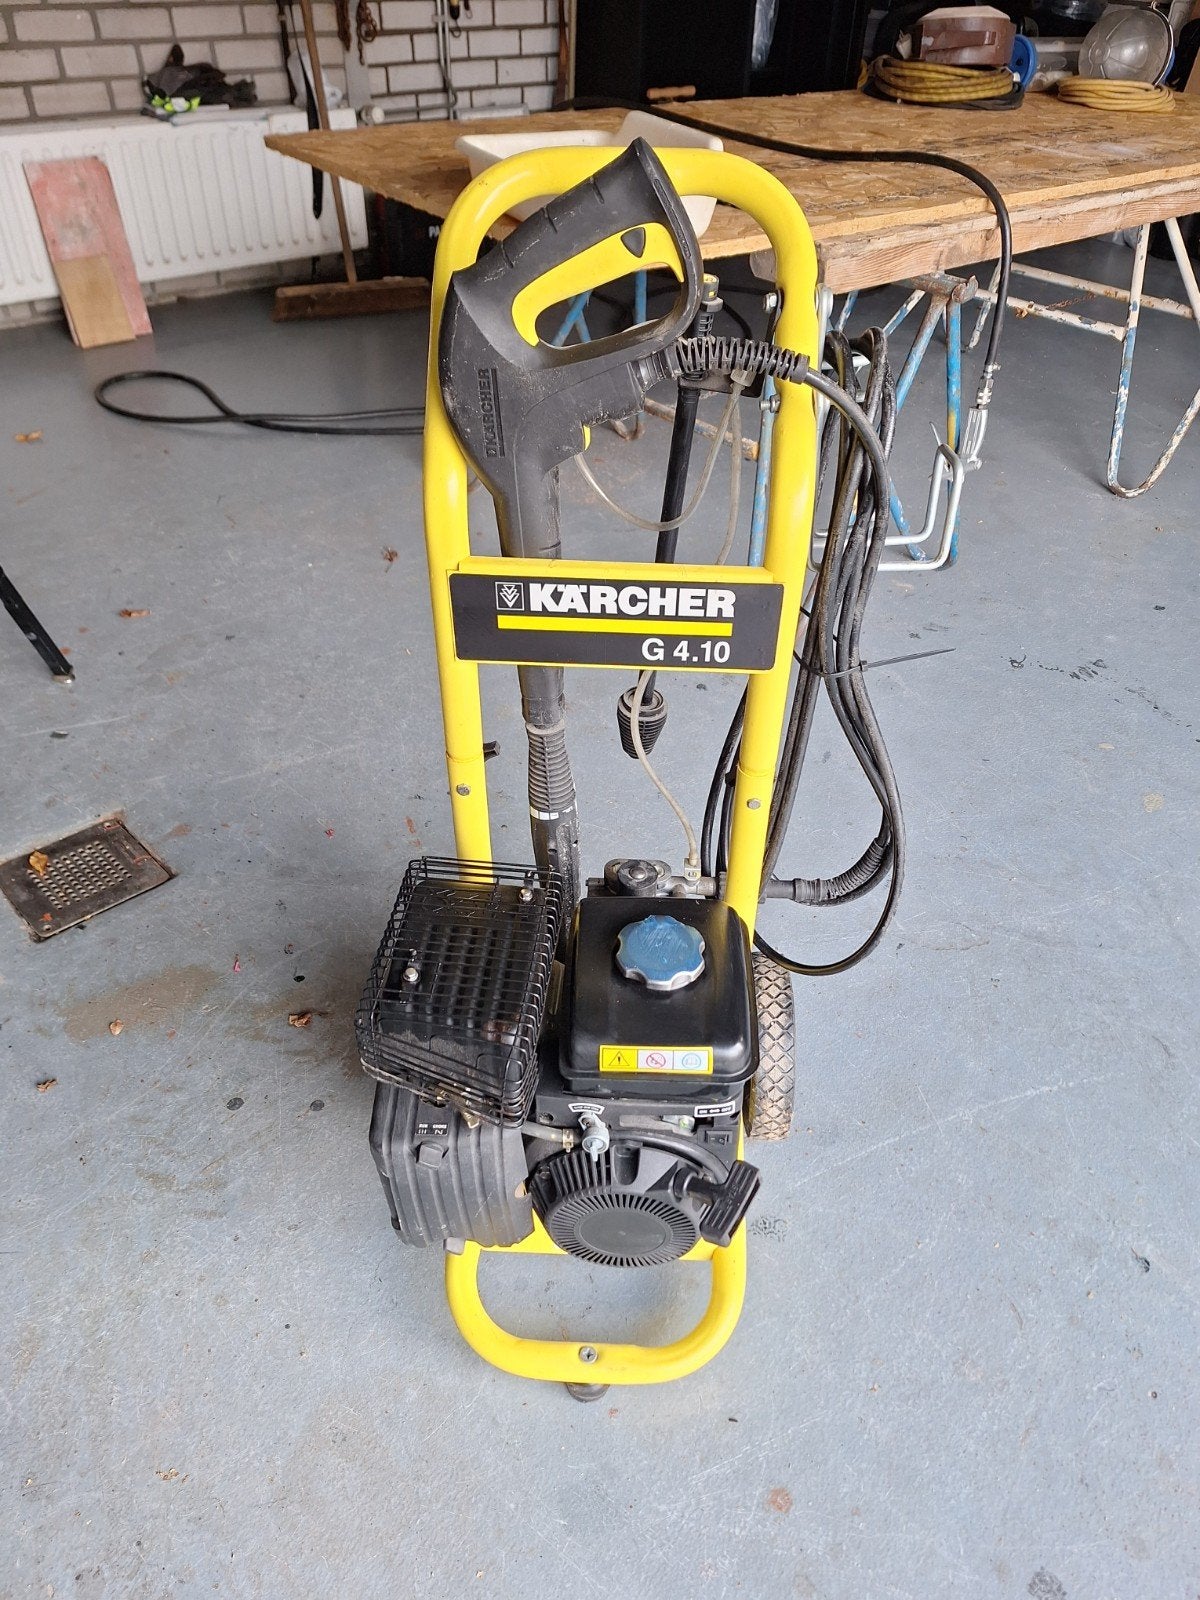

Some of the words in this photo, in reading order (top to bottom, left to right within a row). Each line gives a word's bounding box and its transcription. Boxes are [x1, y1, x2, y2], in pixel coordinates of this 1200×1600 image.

[529, 583, 736, 618] KÄRCHER
[641, 638, 665, 660] G
[672, 641, 731, 663] 4.10
